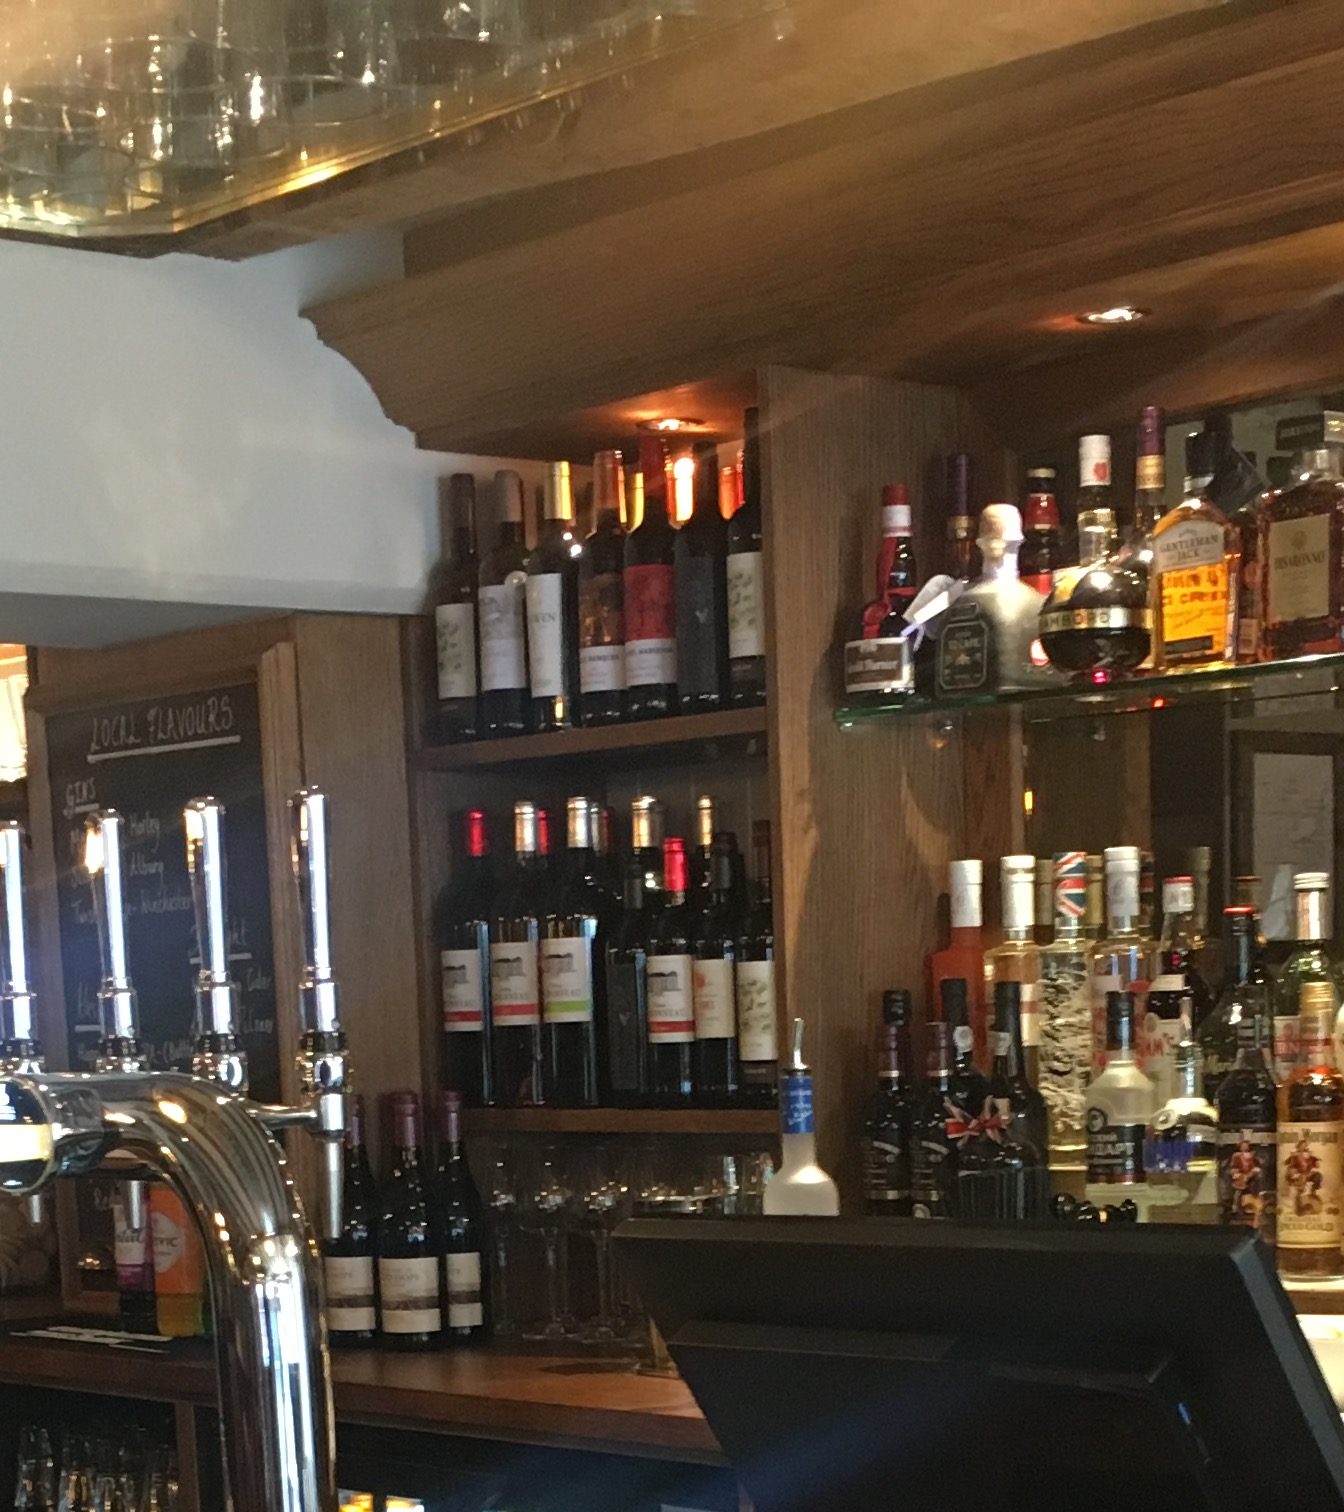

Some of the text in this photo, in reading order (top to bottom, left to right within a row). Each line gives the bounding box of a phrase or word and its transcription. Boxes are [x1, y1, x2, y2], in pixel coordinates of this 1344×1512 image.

[1177, 550, 1201, 562] JACK
[90, 695, 234, 753] LOCAL FLAVOURS
